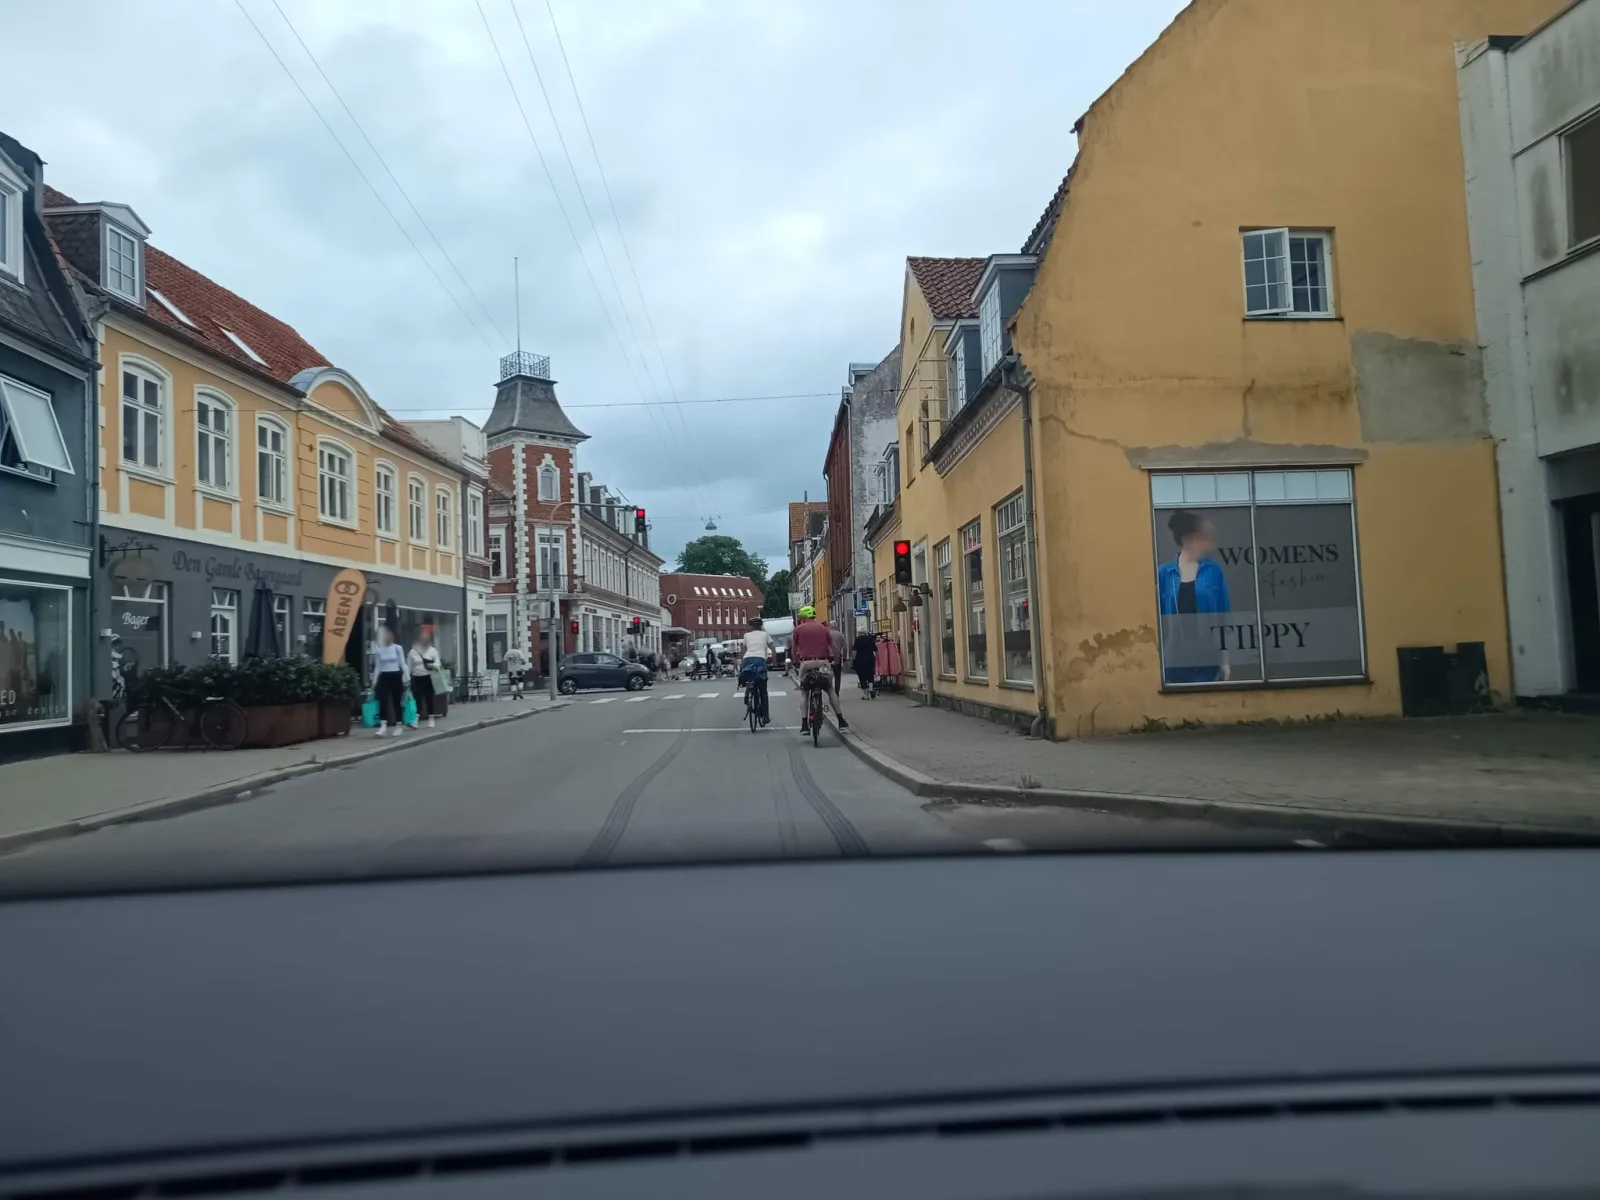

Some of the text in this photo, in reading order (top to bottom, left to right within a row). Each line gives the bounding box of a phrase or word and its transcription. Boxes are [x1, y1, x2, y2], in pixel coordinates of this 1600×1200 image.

[173, 550, 201, 574] Den
[205, 557, 243, 583] Gamle
[1218, 543, 1340, 567] WOMENS
[122, 611, 150, 630] Bager
[328, 596, 353, 637] ÅBEN
[1210, 621, 1312, 651] TIPPY
